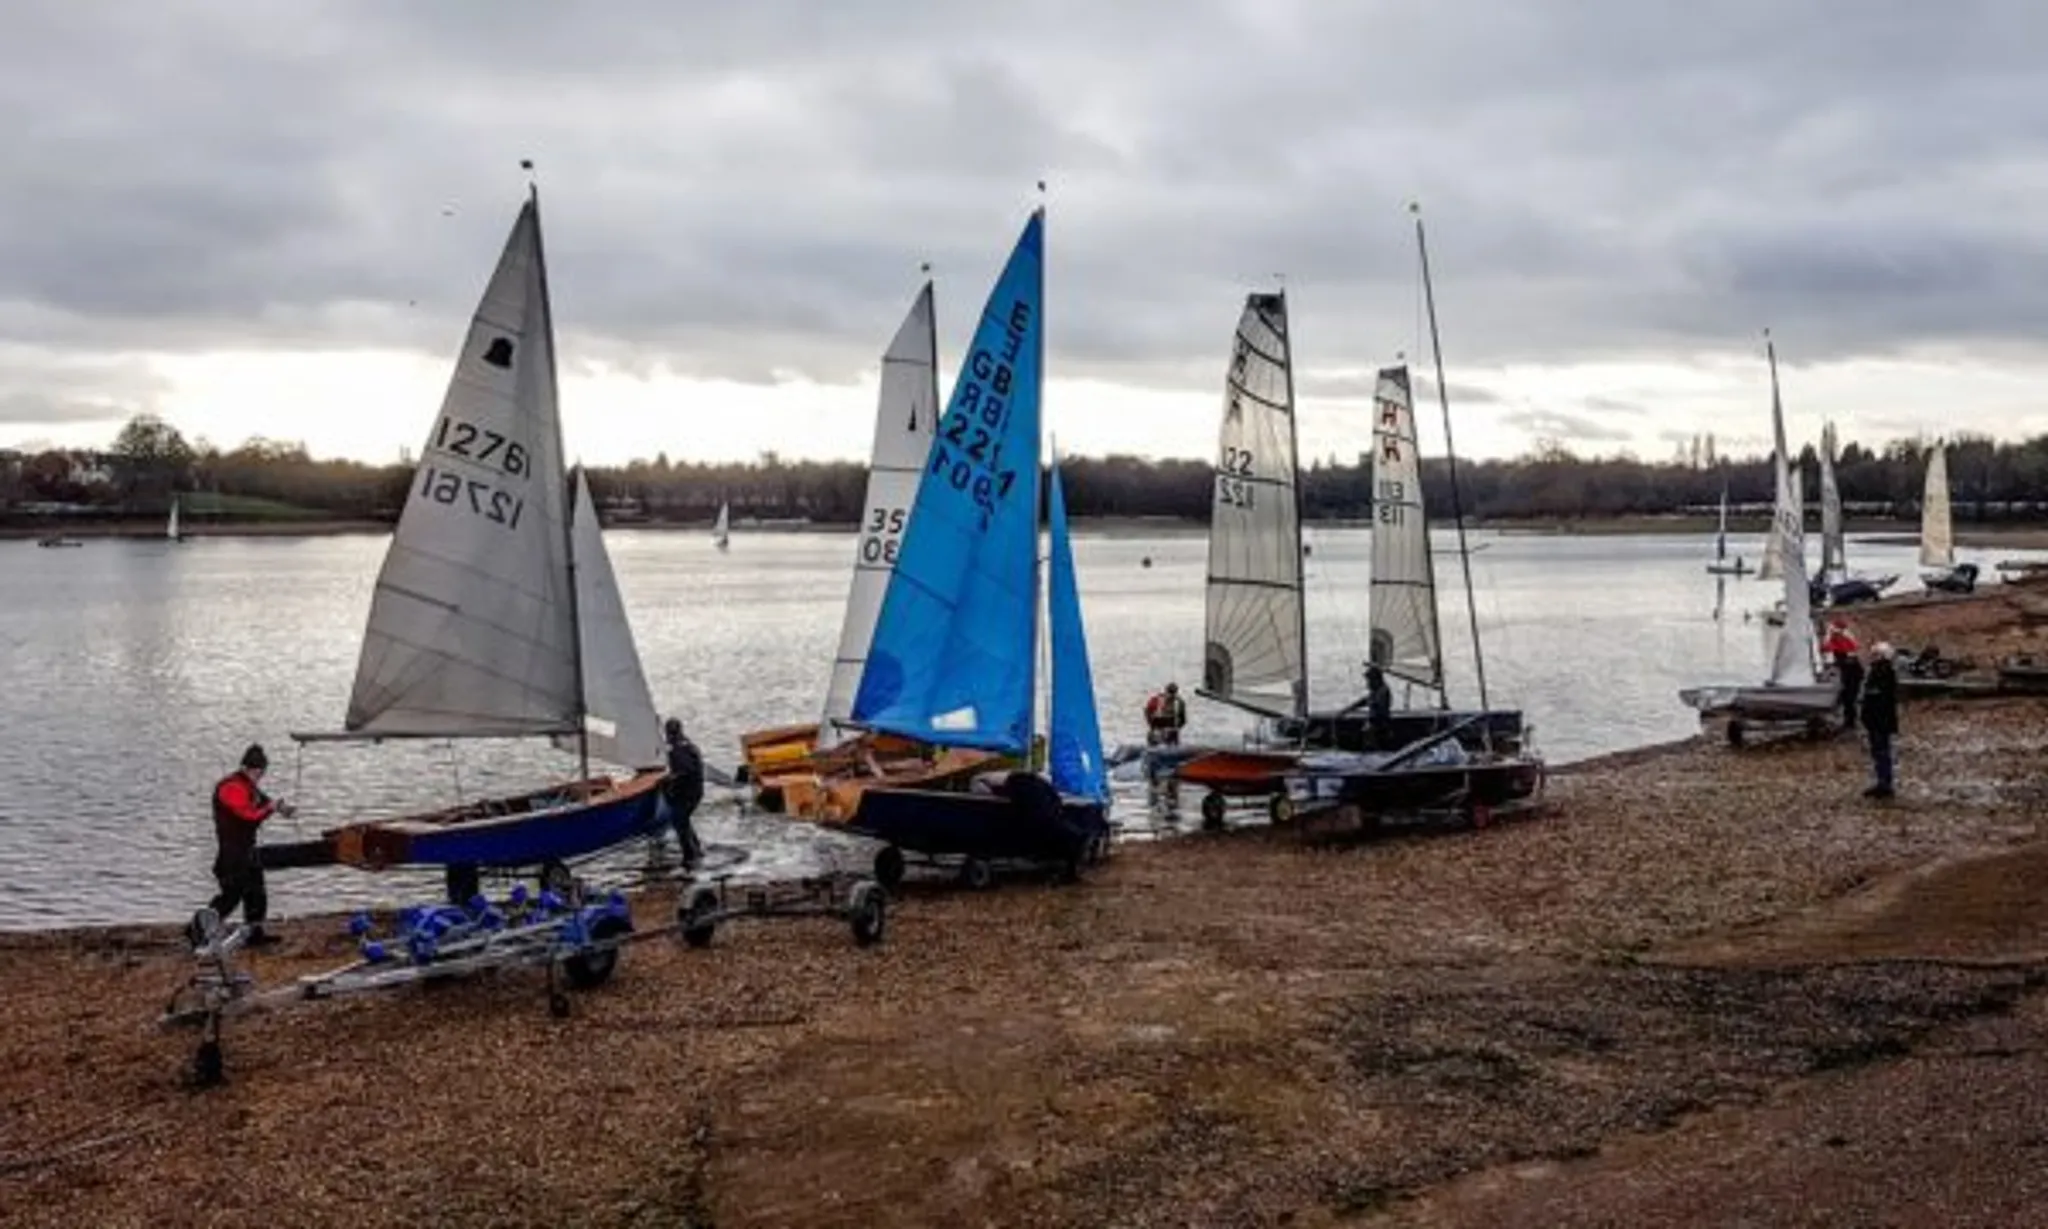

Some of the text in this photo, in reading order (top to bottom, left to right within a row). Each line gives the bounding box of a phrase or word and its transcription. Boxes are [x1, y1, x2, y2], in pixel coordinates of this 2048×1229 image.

[972, 349, 1013, 397] GB
[437, 416, 531, 480] 12761
[867, 508, 906, 534] 35
